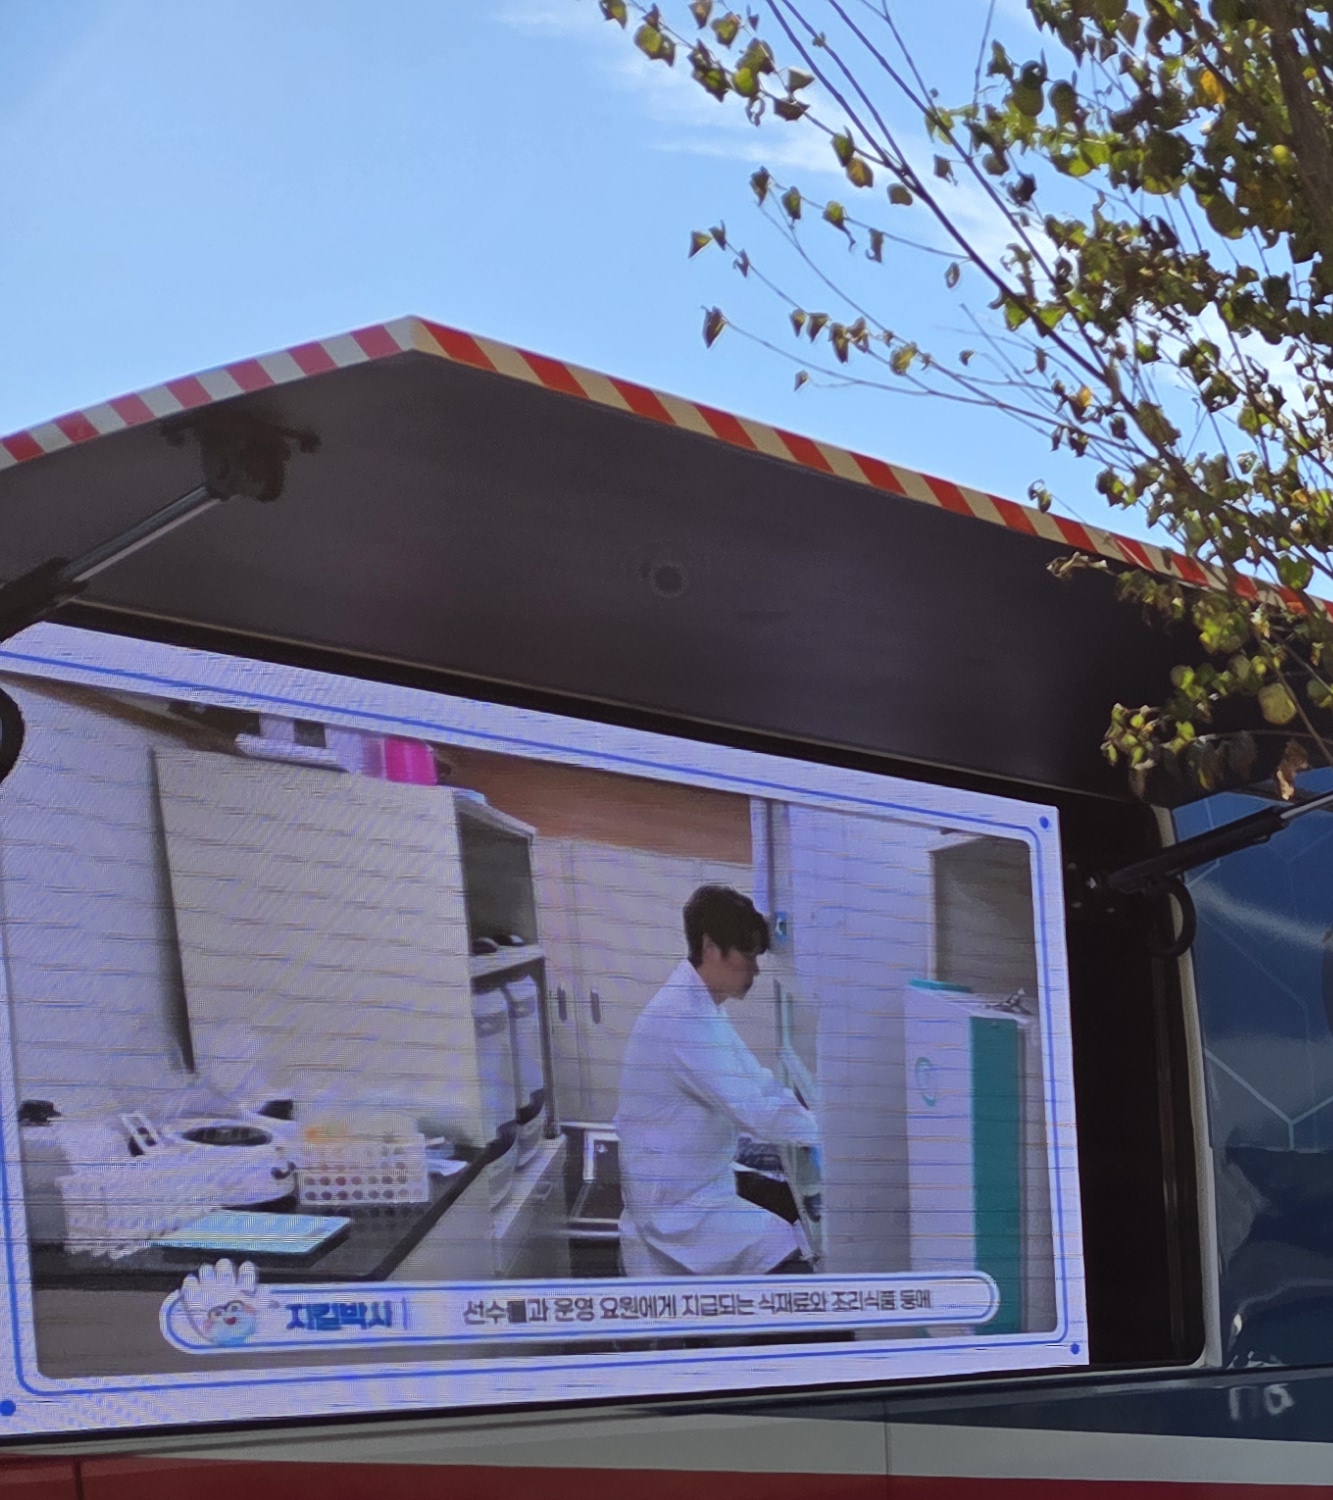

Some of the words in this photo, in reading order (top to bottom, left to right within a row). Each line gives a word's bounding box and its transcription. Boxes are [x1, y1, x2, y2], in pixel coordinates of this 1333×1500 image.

[463, 1297, 549, 1325] 선수과
[553, 1296, 595, 1323] 운영
[600, 1294, 677, 1320] 요원에게
[682, 1293, 755, 1317] 지급되는
